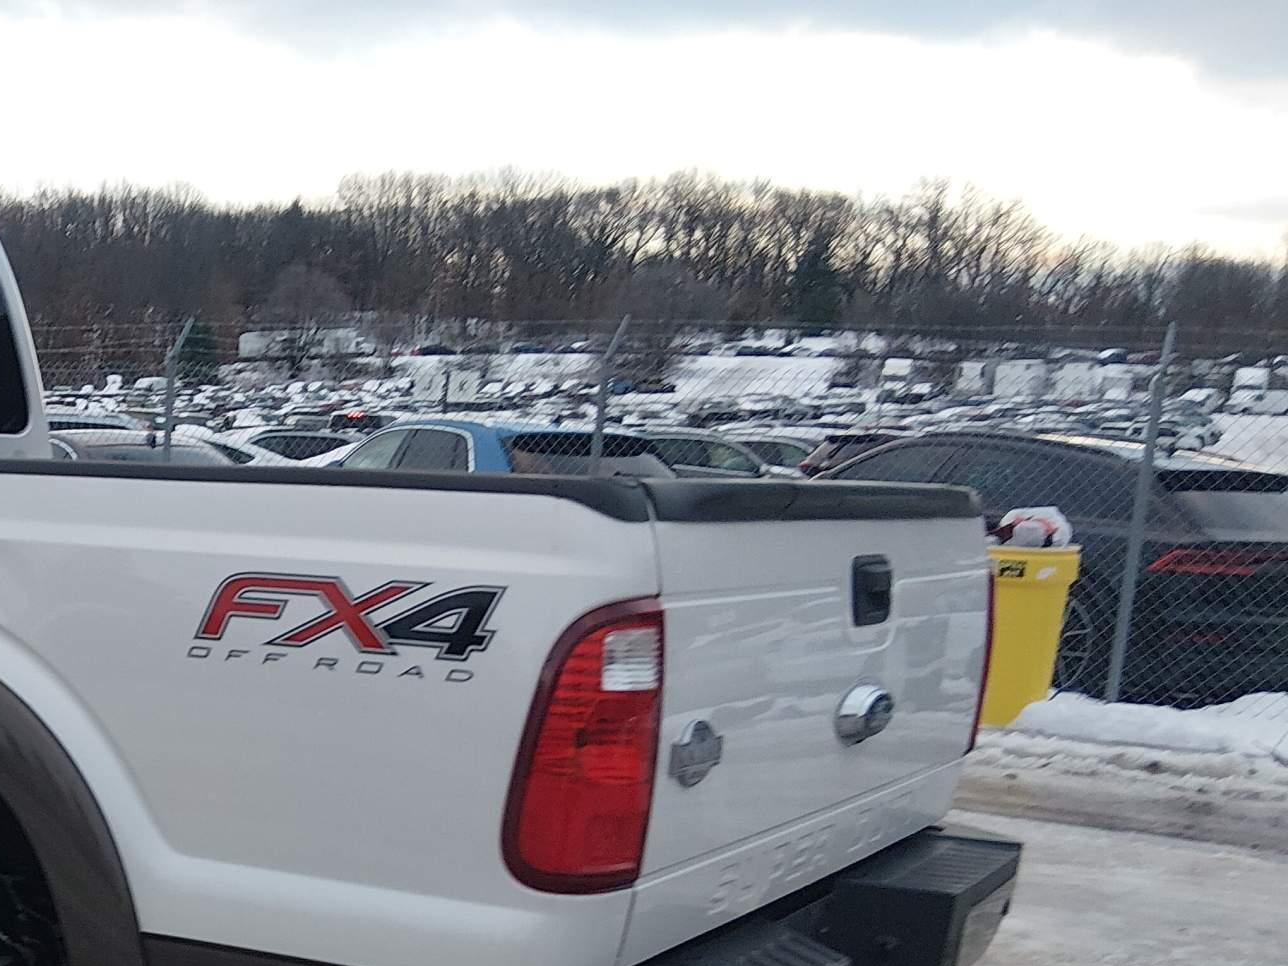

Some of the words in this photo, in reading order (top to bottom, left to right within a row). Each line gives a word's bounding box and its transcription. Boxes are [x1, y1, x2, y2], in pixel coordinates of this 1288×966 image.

[194, 571, 508, 662] FX4
[186, 645, 288, 665] OFF
[313, 657, 474, 682] ROAD
[706, 825, 836, 916] SUPER
